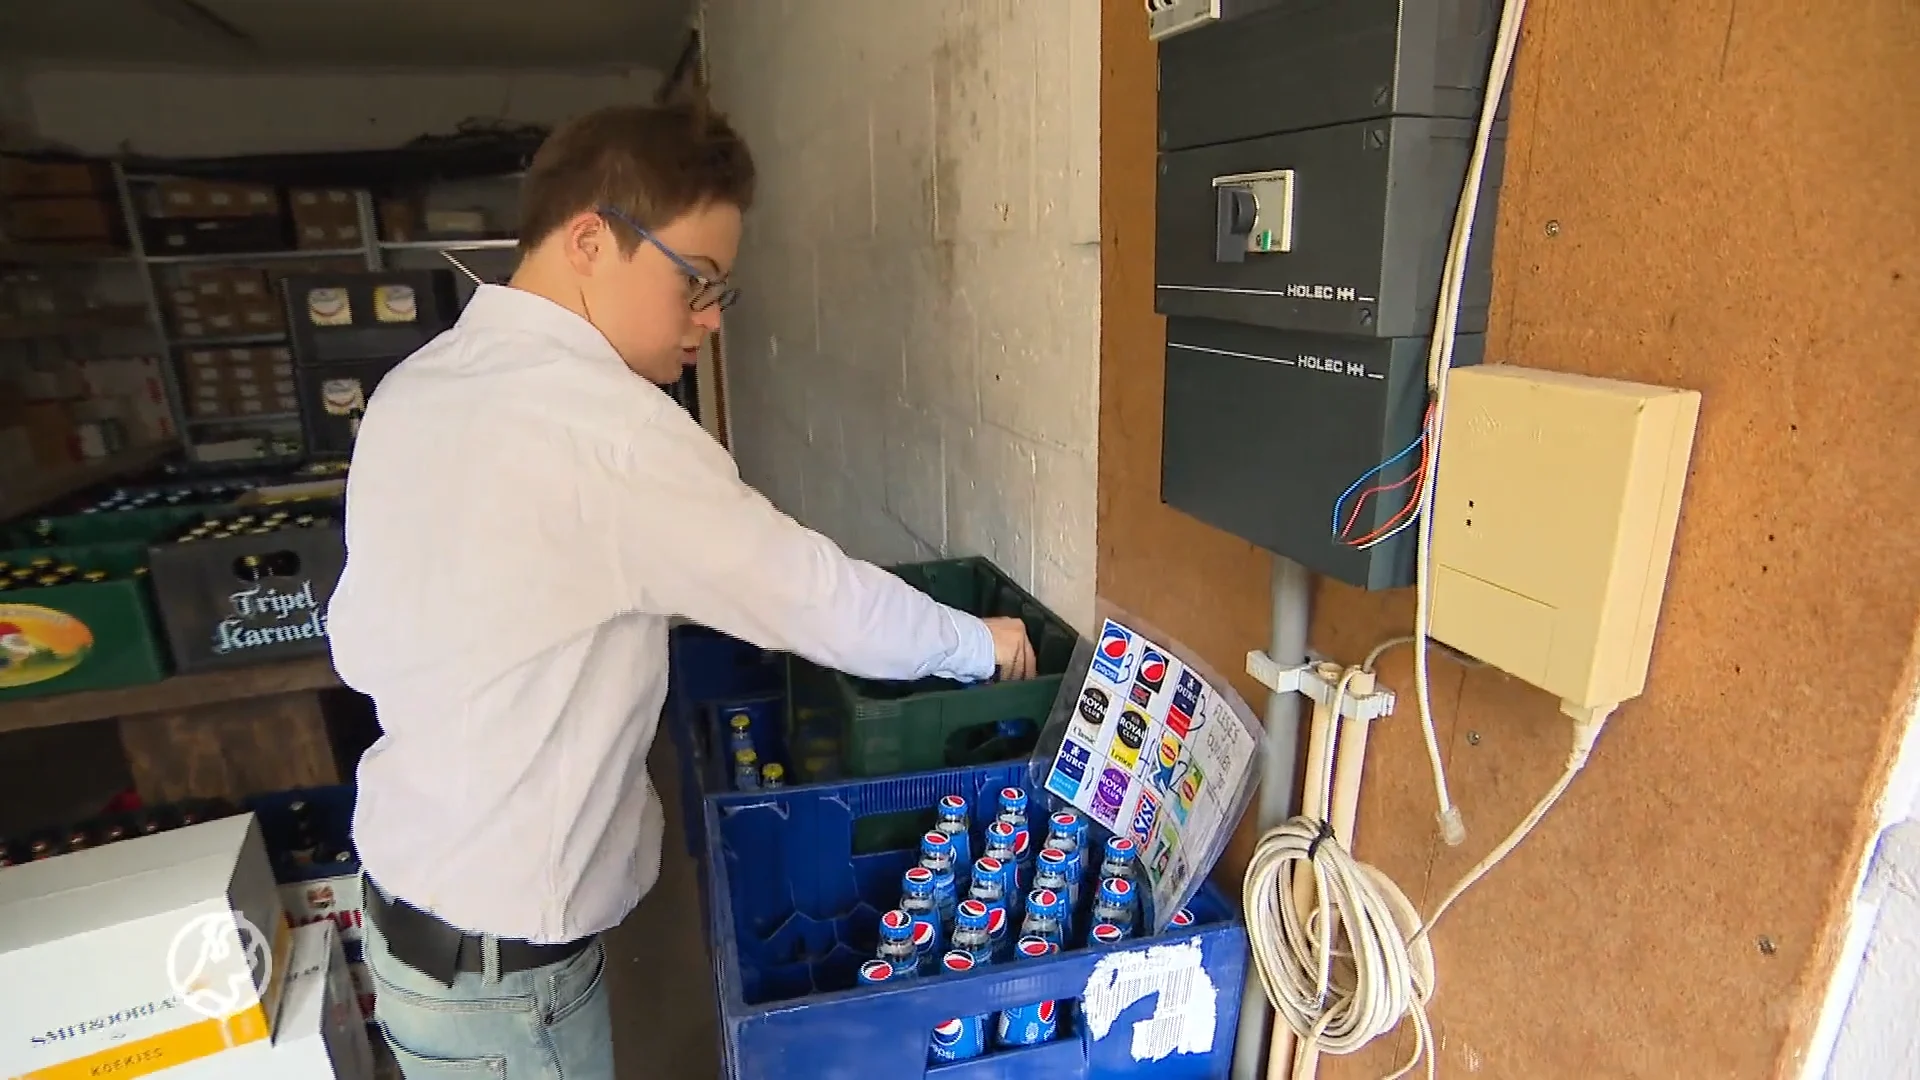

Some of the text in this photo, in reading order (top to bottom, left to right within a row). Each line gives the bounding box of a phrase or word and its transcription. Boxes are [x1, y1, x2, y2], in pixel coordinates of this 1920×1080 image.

[1287, 284, 1333, 300] HOLEC
[1298, 355, 1343, 374] HOLEC
[230, 579, 319, 620] Tripel
[1081, 693, 1108, 716] ROYAL
[1083, 704, 1101, 719] CLUB
[1119, 716, 1147, 739] ROYAL
[1122, 727, 1139, 743] CLUB
[1110, 749, 1135, 771] Lemon
[1100, 774, 1126, 798] ROYAL
[1103, 786, 1119, 800] CLUB
